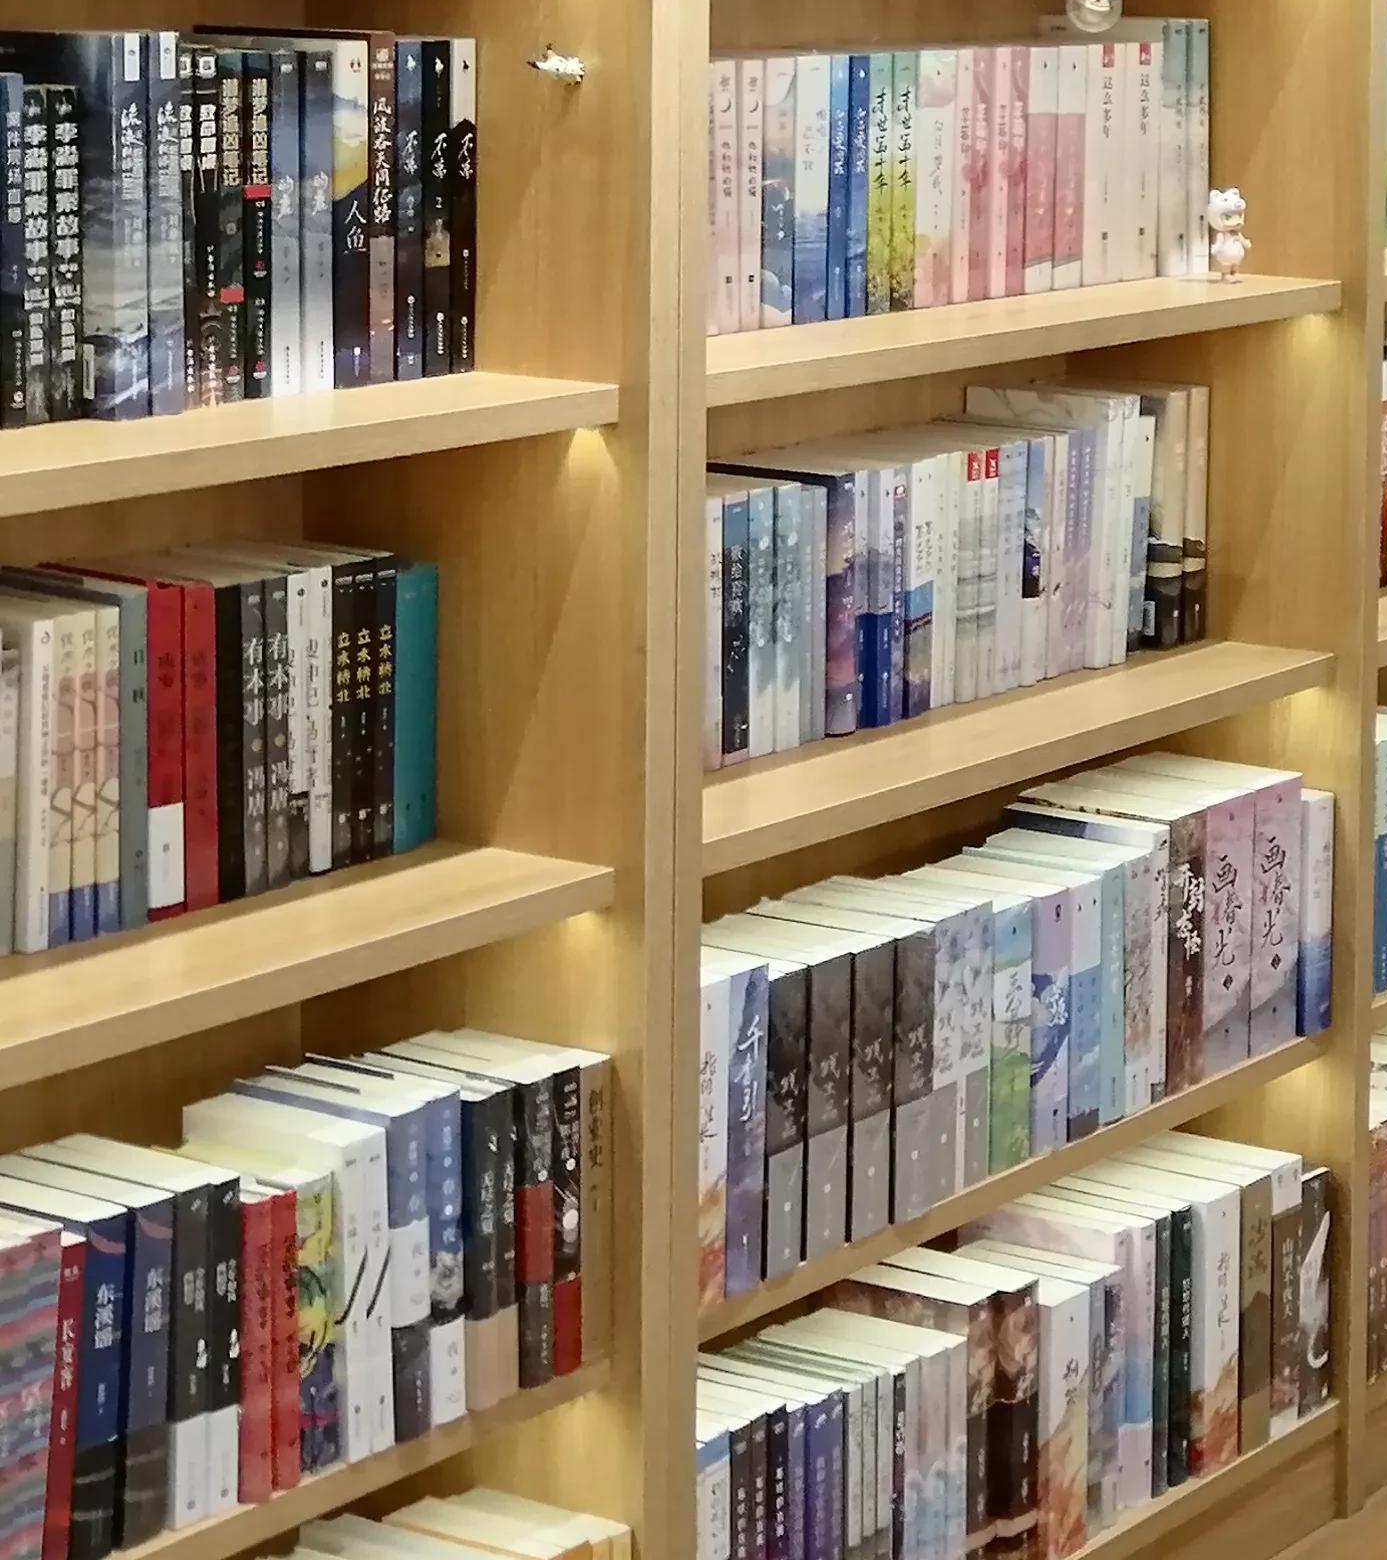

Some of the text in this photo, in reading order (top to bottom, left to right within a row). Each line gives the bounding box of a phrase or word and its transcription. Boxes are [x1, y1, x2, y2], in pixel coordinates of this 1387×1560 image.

[344, 199, 366, 253] 人鱼
[243, 636, 263, 727] 有本事
[268, 632, 287, 716] 有本事
[1174, 863, 1205, 960] 开封志怪
